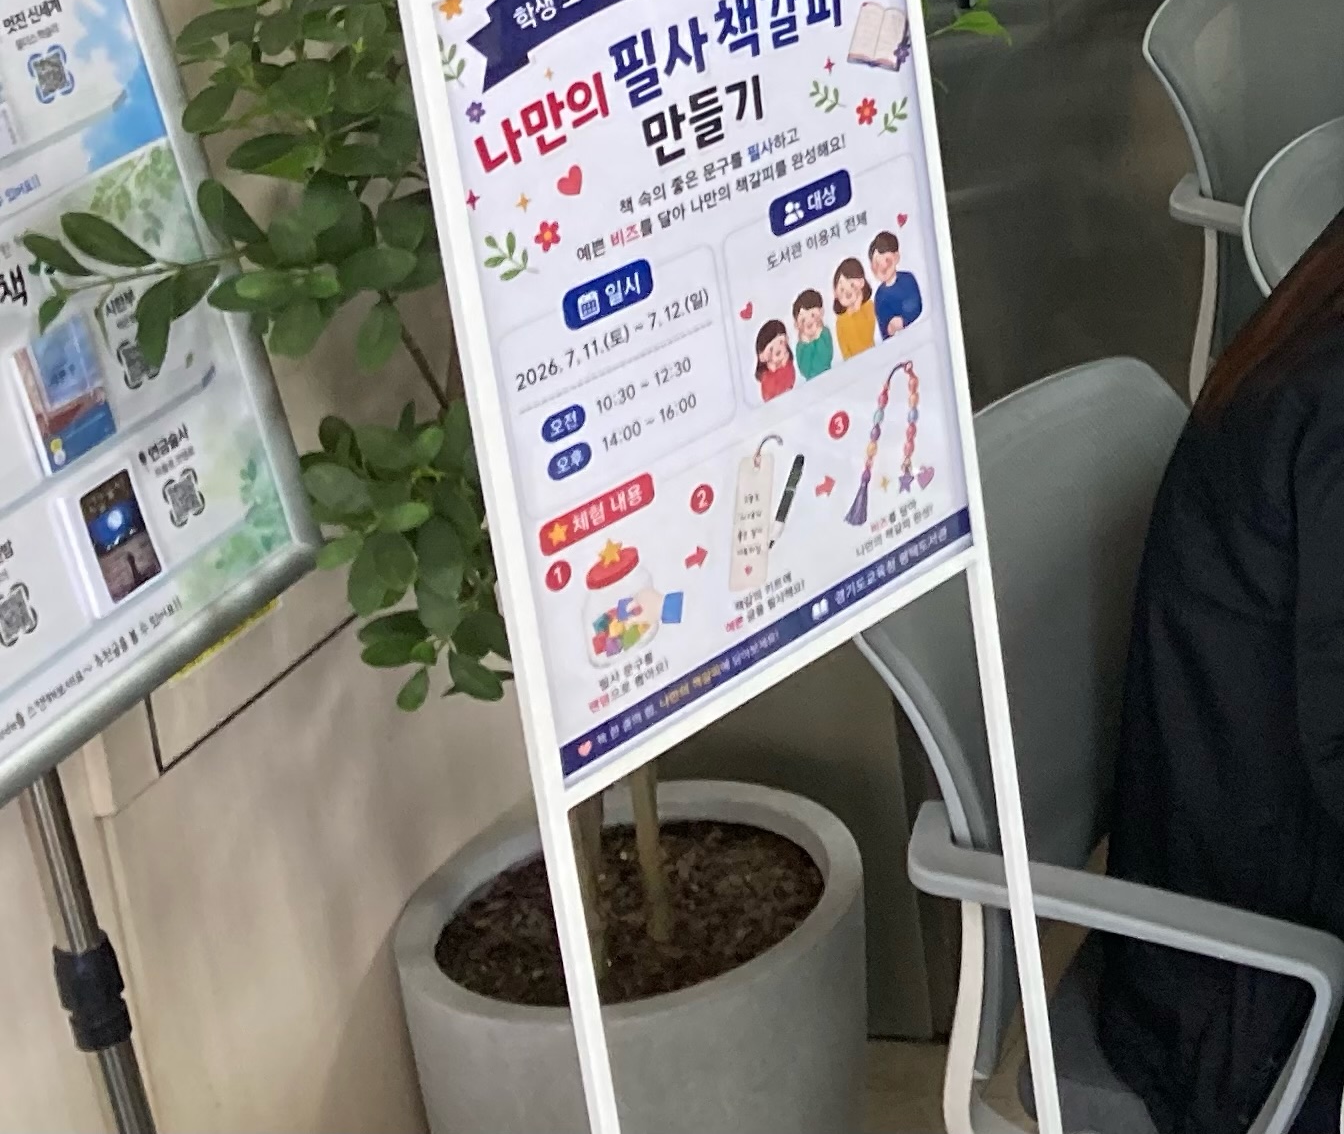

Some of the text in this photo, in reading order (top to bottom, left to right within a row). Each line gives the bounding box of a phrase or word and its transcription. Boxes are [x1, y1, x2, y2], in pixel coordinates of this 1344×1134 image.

[3, 10, 27, 35] 멋진
[474, 71, 609, 174] 나만의
[608, 16, 710, 108] 필사
[642, 74, 764, 167] 만들기
[576, 135, 847, 262] 예쁜 비즈를 달아 나만의 책갈피를 완성해요!
[619, 127, 800, 216] 책 속의 좋은 문구를 필사하고
[806, 185, 837, 213] 대상
[765, 211, 868, 271] 도서관 이용자 전체
[604, 271, 641, 307] 일시
[550, 410, 578, 437] 오전
[596, 385, 637, 414] 10:30
[654, 357, 692, 387] 12:30
[556, 448, 585, 473] 오후
[602, 421, 643, 452] 14:00
[659, 393, 697, 424] 16:00
[572, 483, 643, 534] 체험 내용
[697, 489, 707, 508] 2
[553, 566, 563, 585] 1
[833, 554, 897, 607] 경기도교육청
